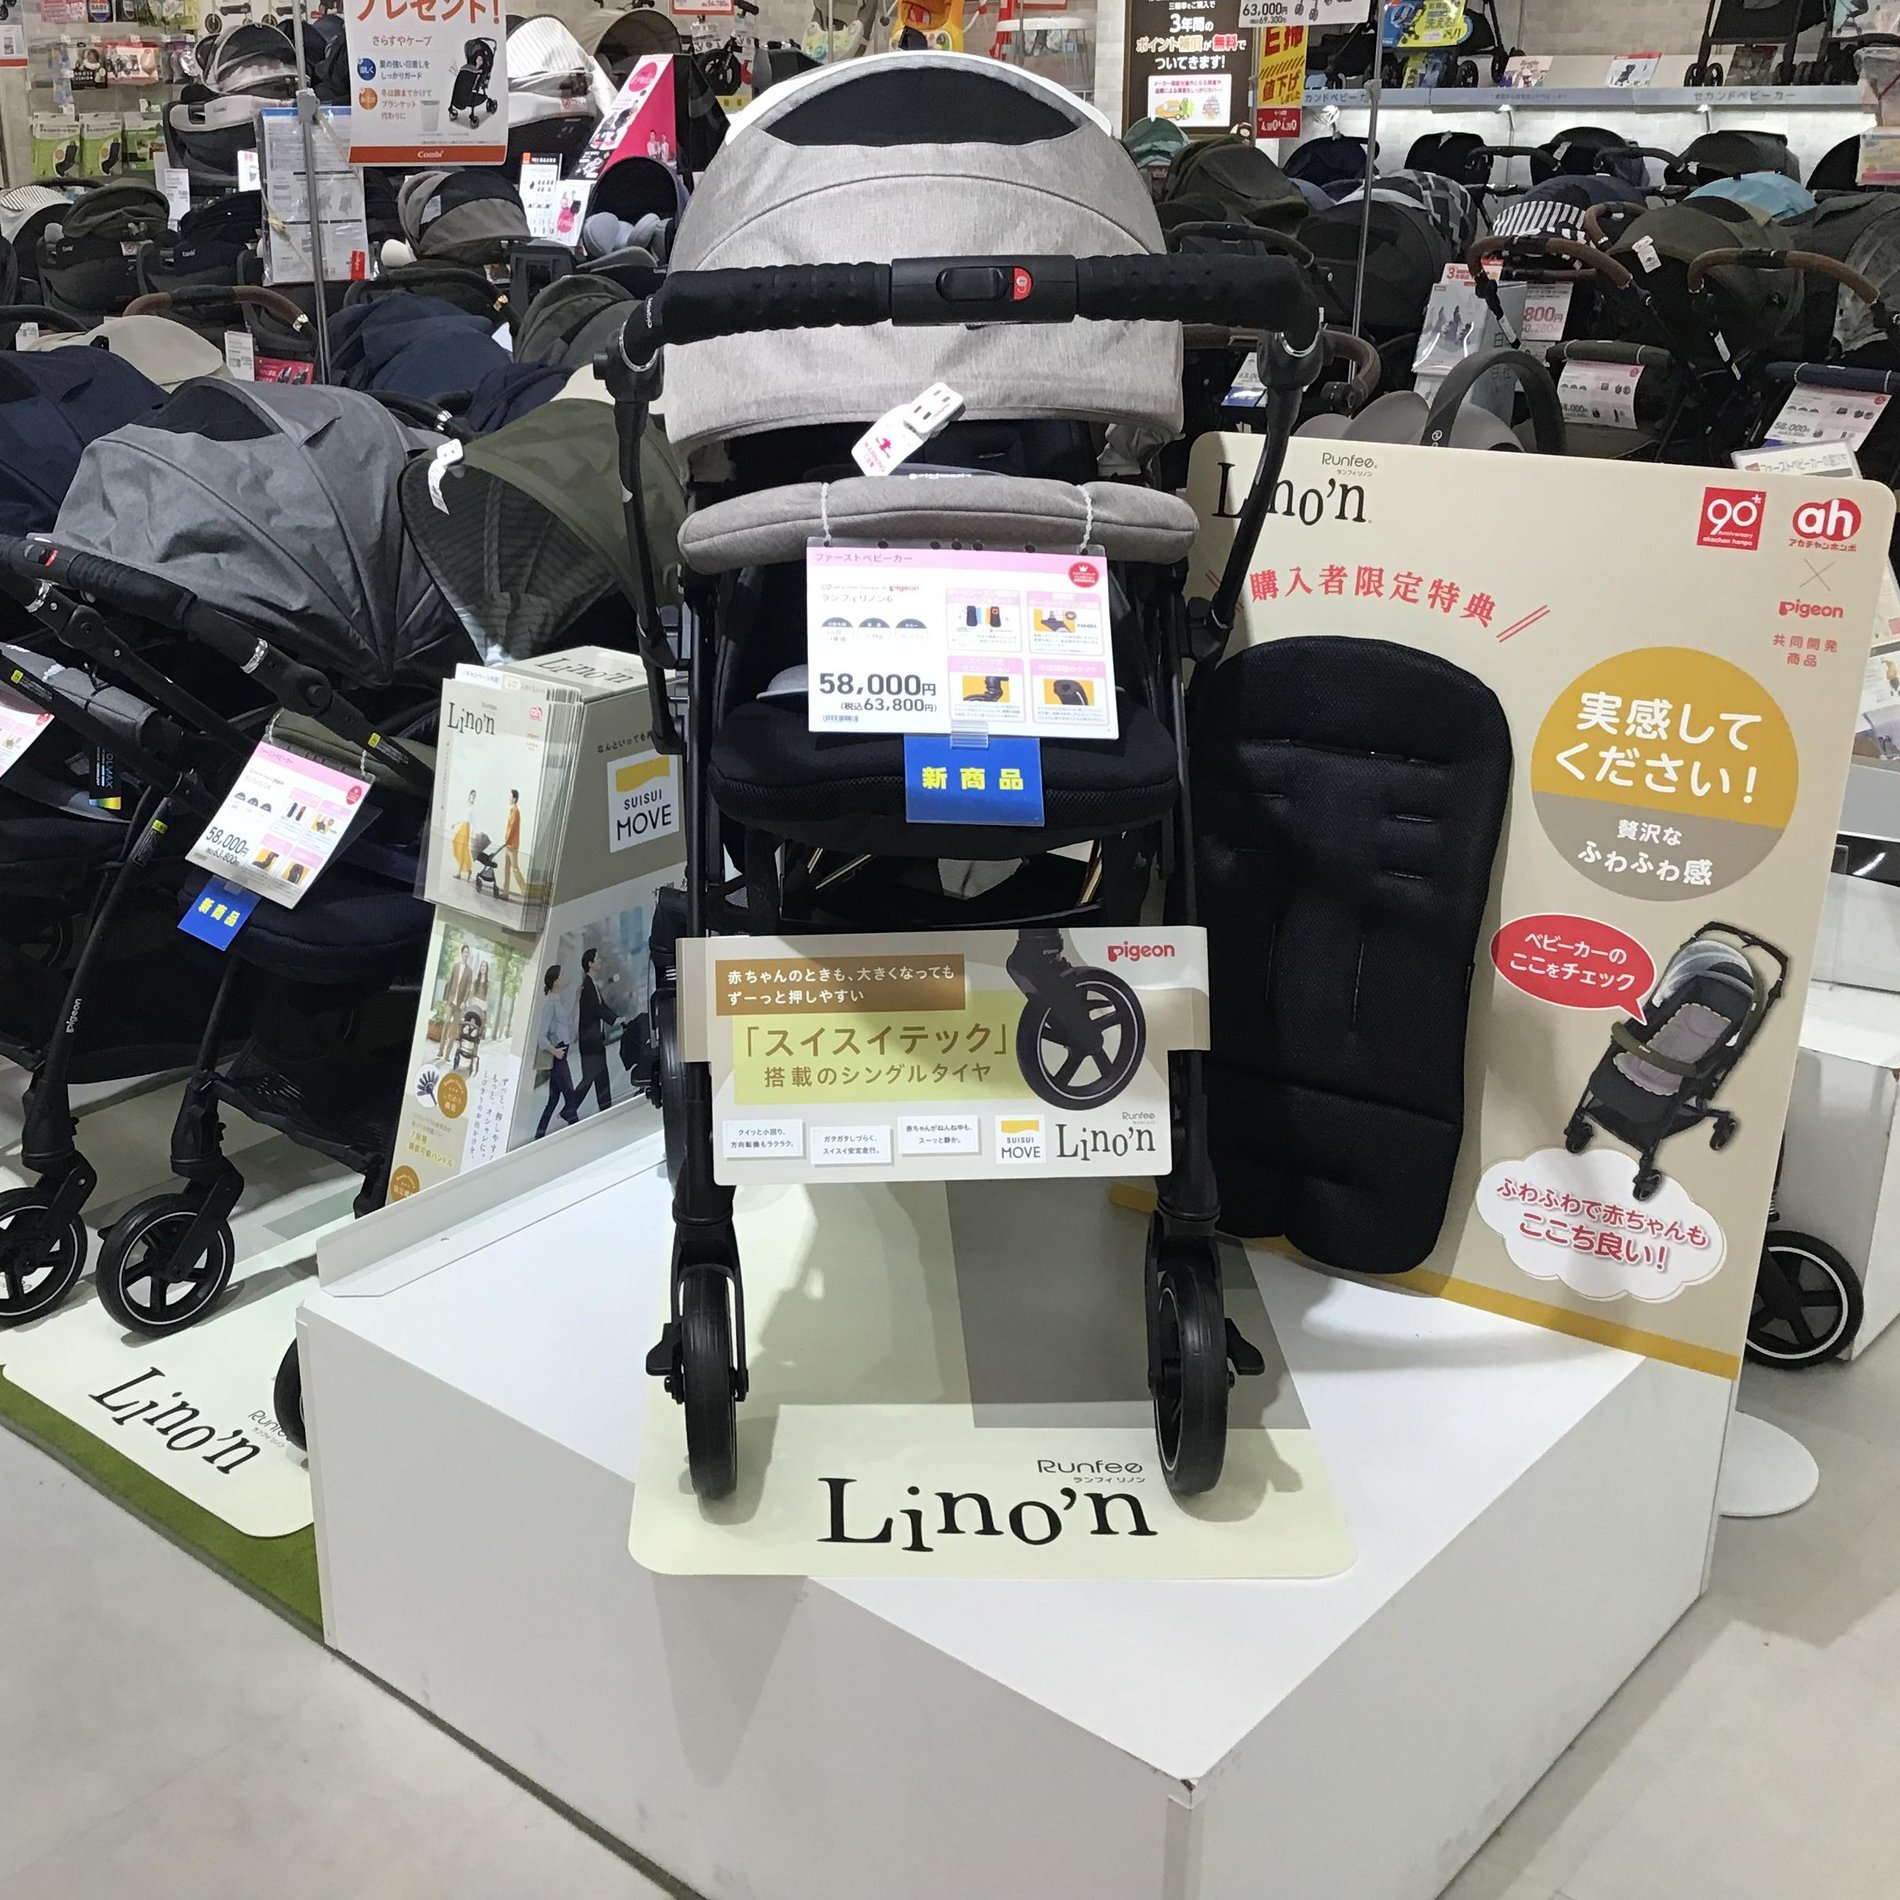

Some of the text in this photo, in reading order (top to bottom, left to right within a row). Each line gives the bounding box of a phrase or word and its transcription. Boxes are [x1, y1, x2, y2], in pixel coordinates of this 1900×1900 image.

[1694, 91, 1796, 101] セカンドベビーカー
[417, 150, 444, 158] Combi
[1321, 452, 1376, 469] Runfee
[1212, 462, 1367, 526] Lno’n
[1797, 499, 1854, 538] ah
[815, 553, 914, 563] ファーストベビーカー
[1788, 538, 1857, 552] アカチャンホンポ
[1250, 564, 1497, 628] 購入者限定特典
[1772, 633, 1838, 653] 共同開発
[1786, 652, 1818, 667] 商品
[818, 672, 937, 698] 58,000円
[1577, 690, 1763, 752] 実感して
[921, 766, 1025, 791] 新商品
[1554, 742, 1759, 804] ください!
[624, 789, 662, 811] SUISUI
[616, 804, 672, 841] MOVE
[1617, 818, 1683, 847] 贅沢な
[1577, 840, 1714, 887] ふわふわ感
[1524, 932, 1628, 966] ベビーカーの
[727, 964, 956, 985] 赤ちゃんのときも、大きくなっても
[1509, 951, 1636, 992] ここをチェック
[727, 988, 865, 1007] ずーっと押しやすい
[746, 1022, 1008, 1058] 「スイスイテック」
[764, 1063, 992, 1089] 搭載のシングルタイヤ
[1001, 1146, 1041, 1159] MOVE
[1006, 1136, 1035, 1144] SUISUI
[1496, 1176, 1710, 1248] ふわふわで赤ちゃんも
[1518, 1212, 1669, 1272] ここち良い!
[1036, 1458, 1144, 1475] Runfee
